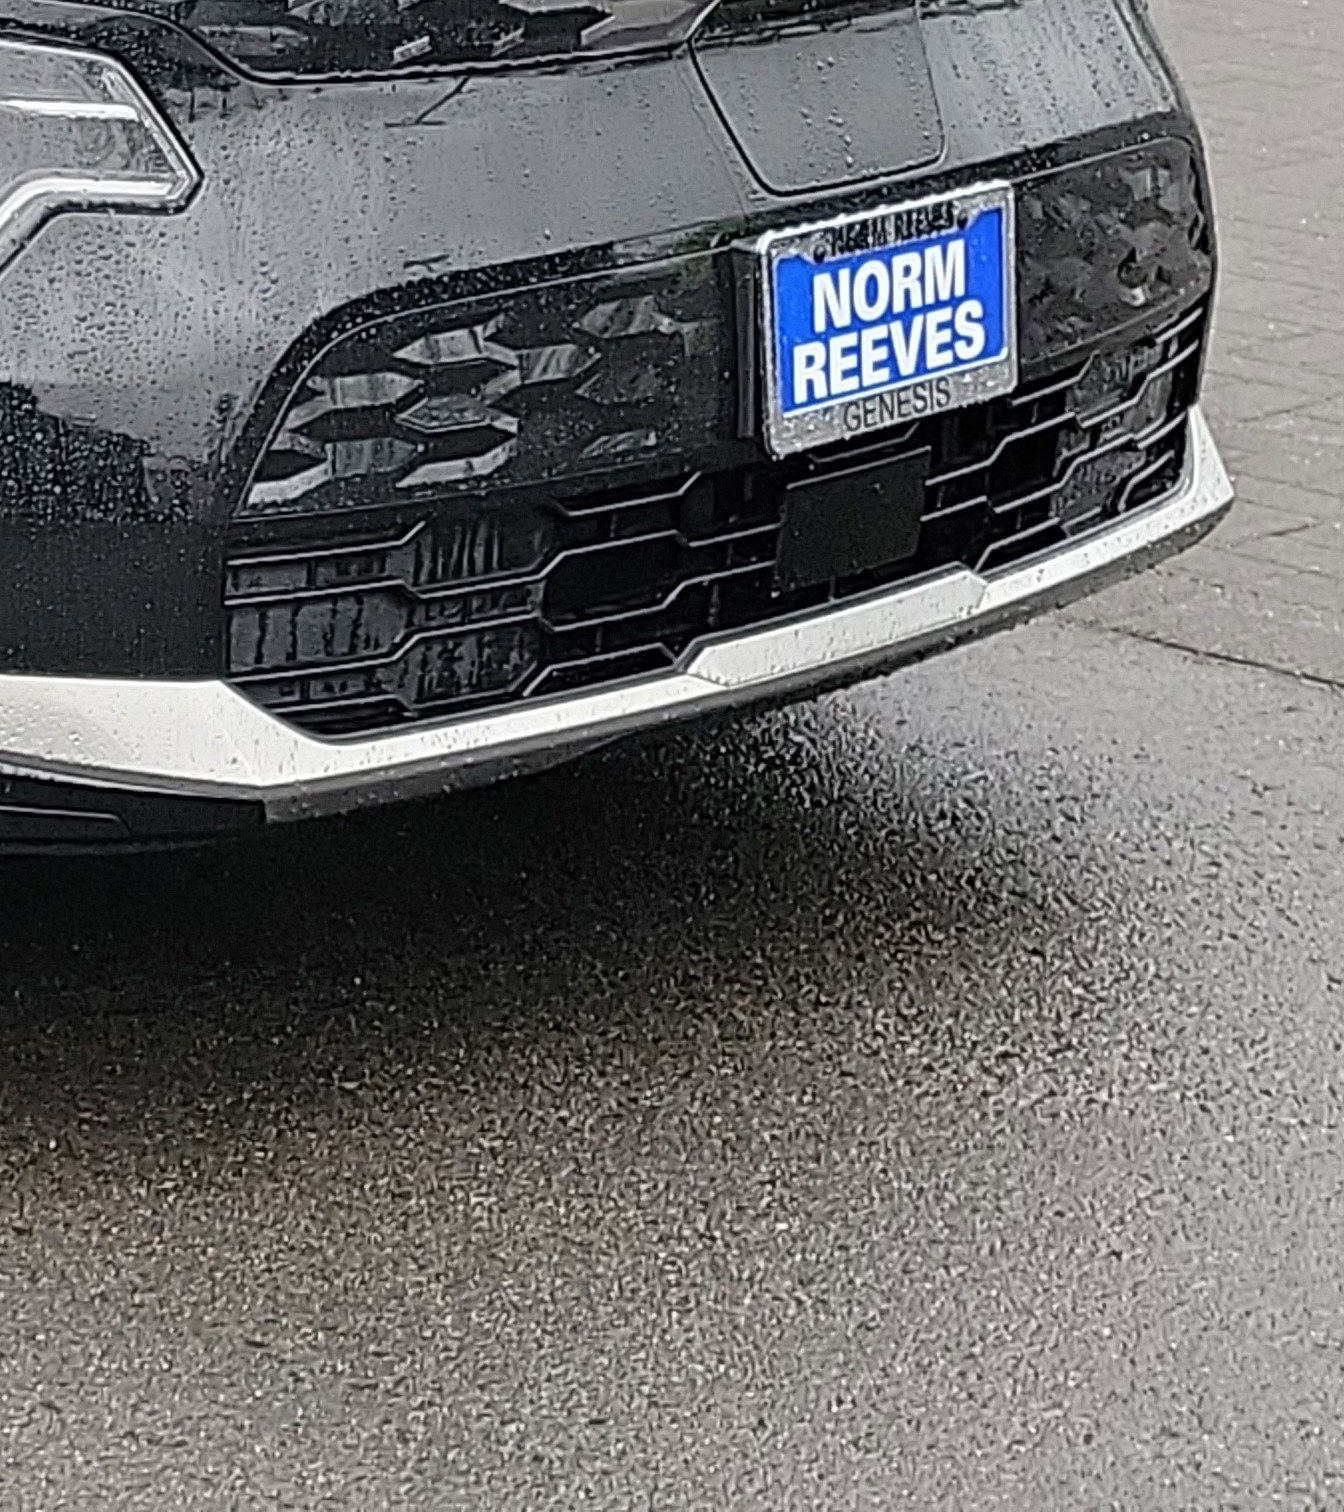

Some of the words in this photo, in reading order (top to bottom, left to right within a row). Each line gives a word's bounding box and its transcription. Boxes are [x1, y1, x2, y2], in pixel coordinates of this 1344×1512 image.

[813, 238, 966, 334] NORM
[793, 299, 986, 405] REEVES
[842, 376, 952, 433] GENESIS
